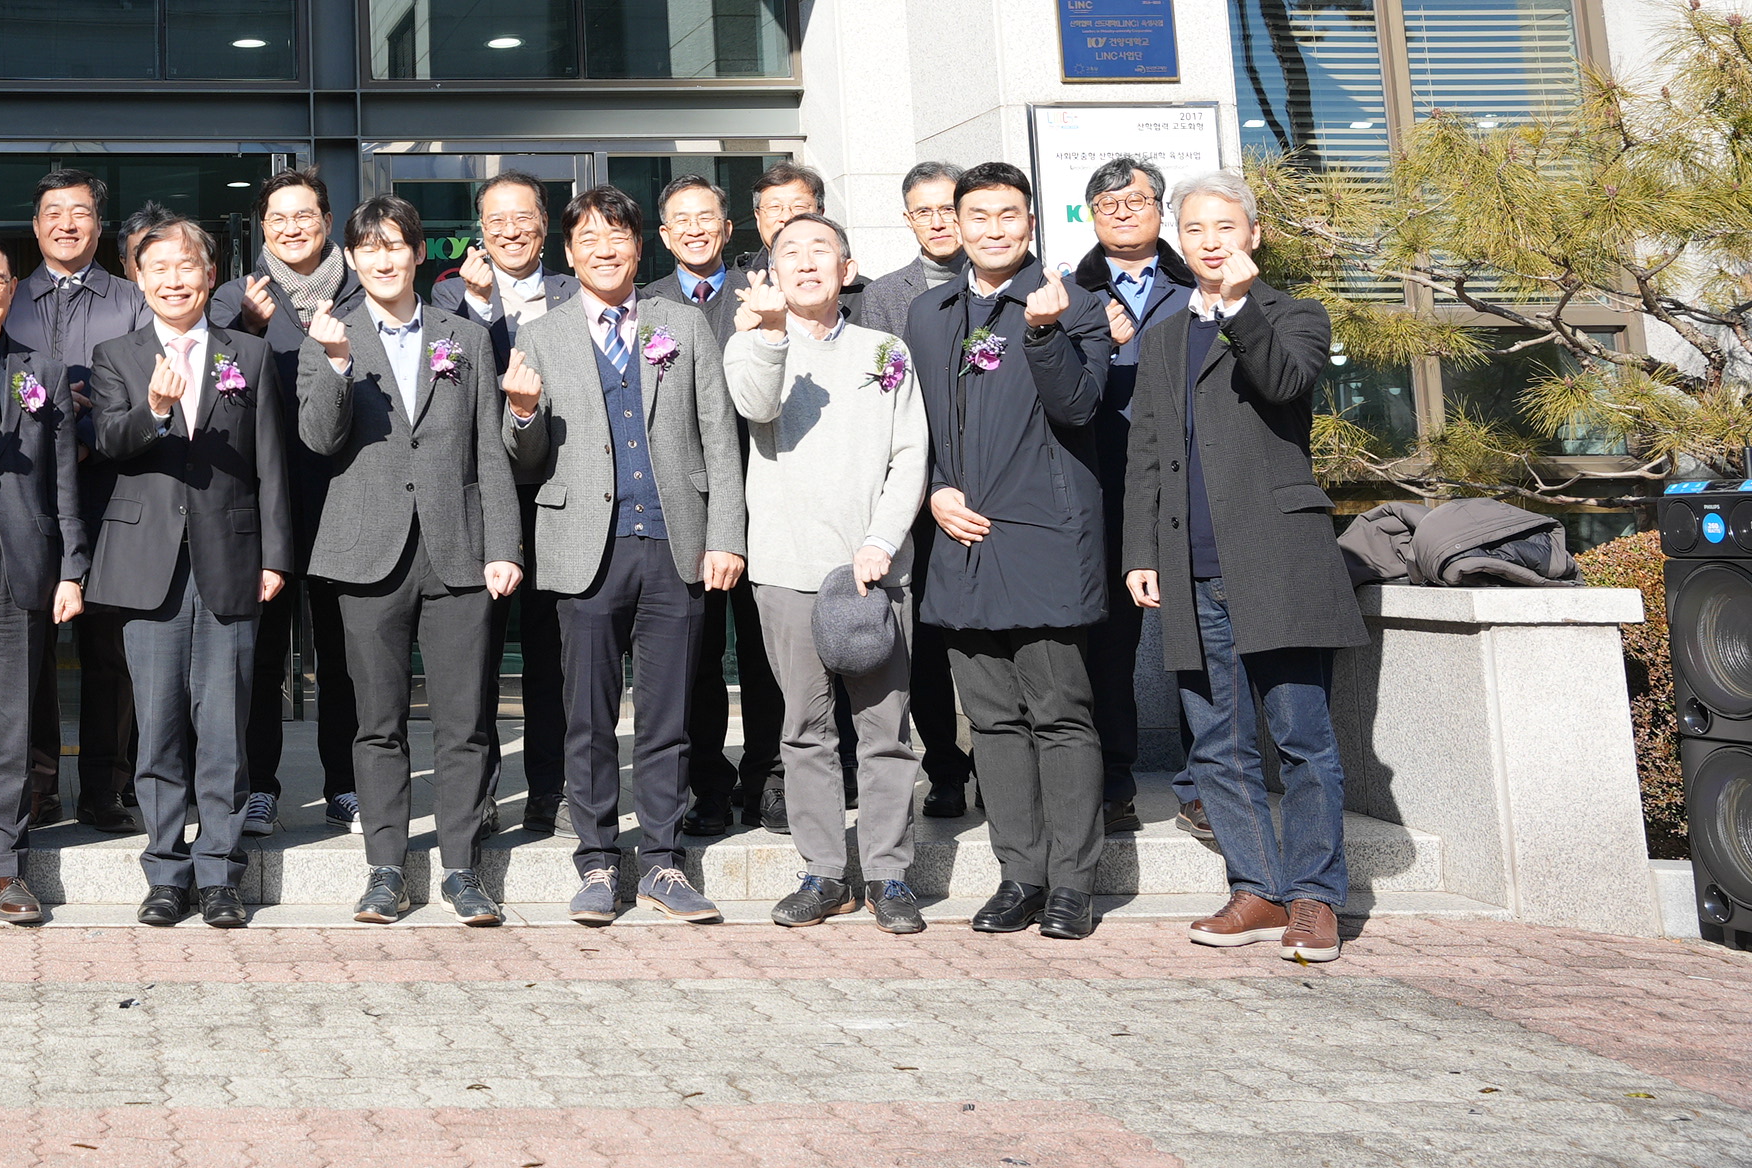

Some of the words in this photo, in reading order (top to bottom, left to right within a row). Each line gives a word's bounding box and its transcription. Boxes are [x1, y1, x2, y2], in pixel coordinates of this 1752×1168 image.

[1068, 0, 1093, 10] LINC
[1109, 37, 1150, 47] 건양대학교
[1179, 112, 1204, 120] 2017
[1137, 122, 1169, 132] 산학협력
[1172, 122, 1205, 132] 고도화형
[1056, 152, 1097, 161] 사회맞춤형
[1169, 152, 1202, 161] 육성사업
